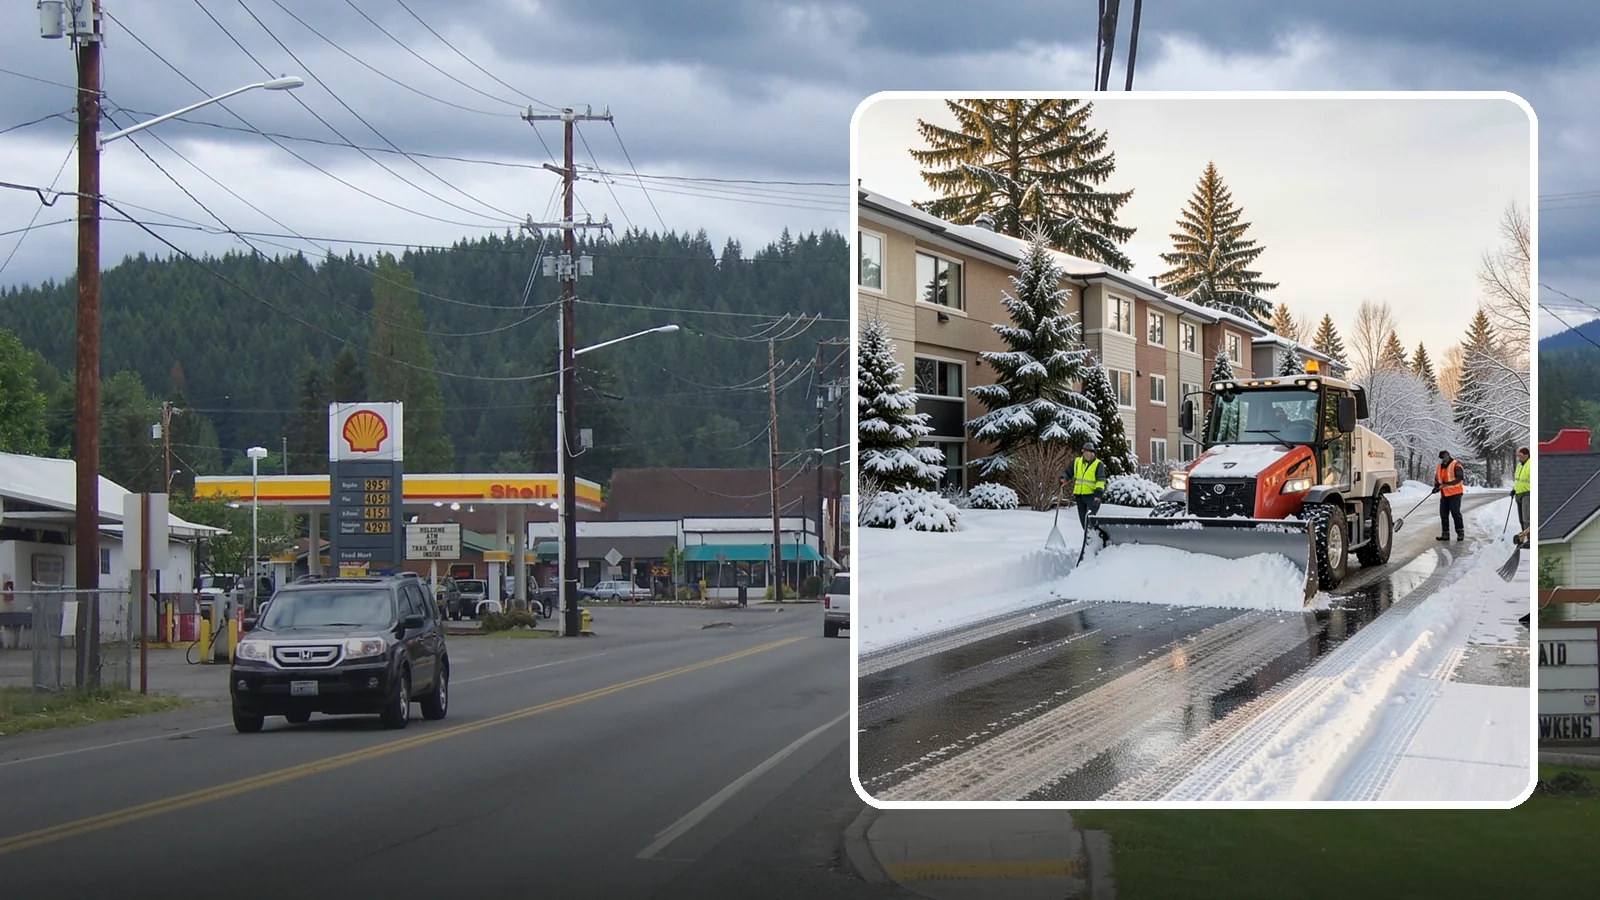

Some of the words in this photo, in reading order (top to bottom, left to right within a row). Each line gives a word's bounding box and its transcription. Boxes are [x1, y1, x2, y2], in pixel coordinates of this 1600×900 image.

[366, 480, 383, 490] 395
[490, 484, 547, 499] Shell
[366, 494, 383, 504] 405
[366, 508, 383, 518] 415
[366, 522, 383, 532] 429
